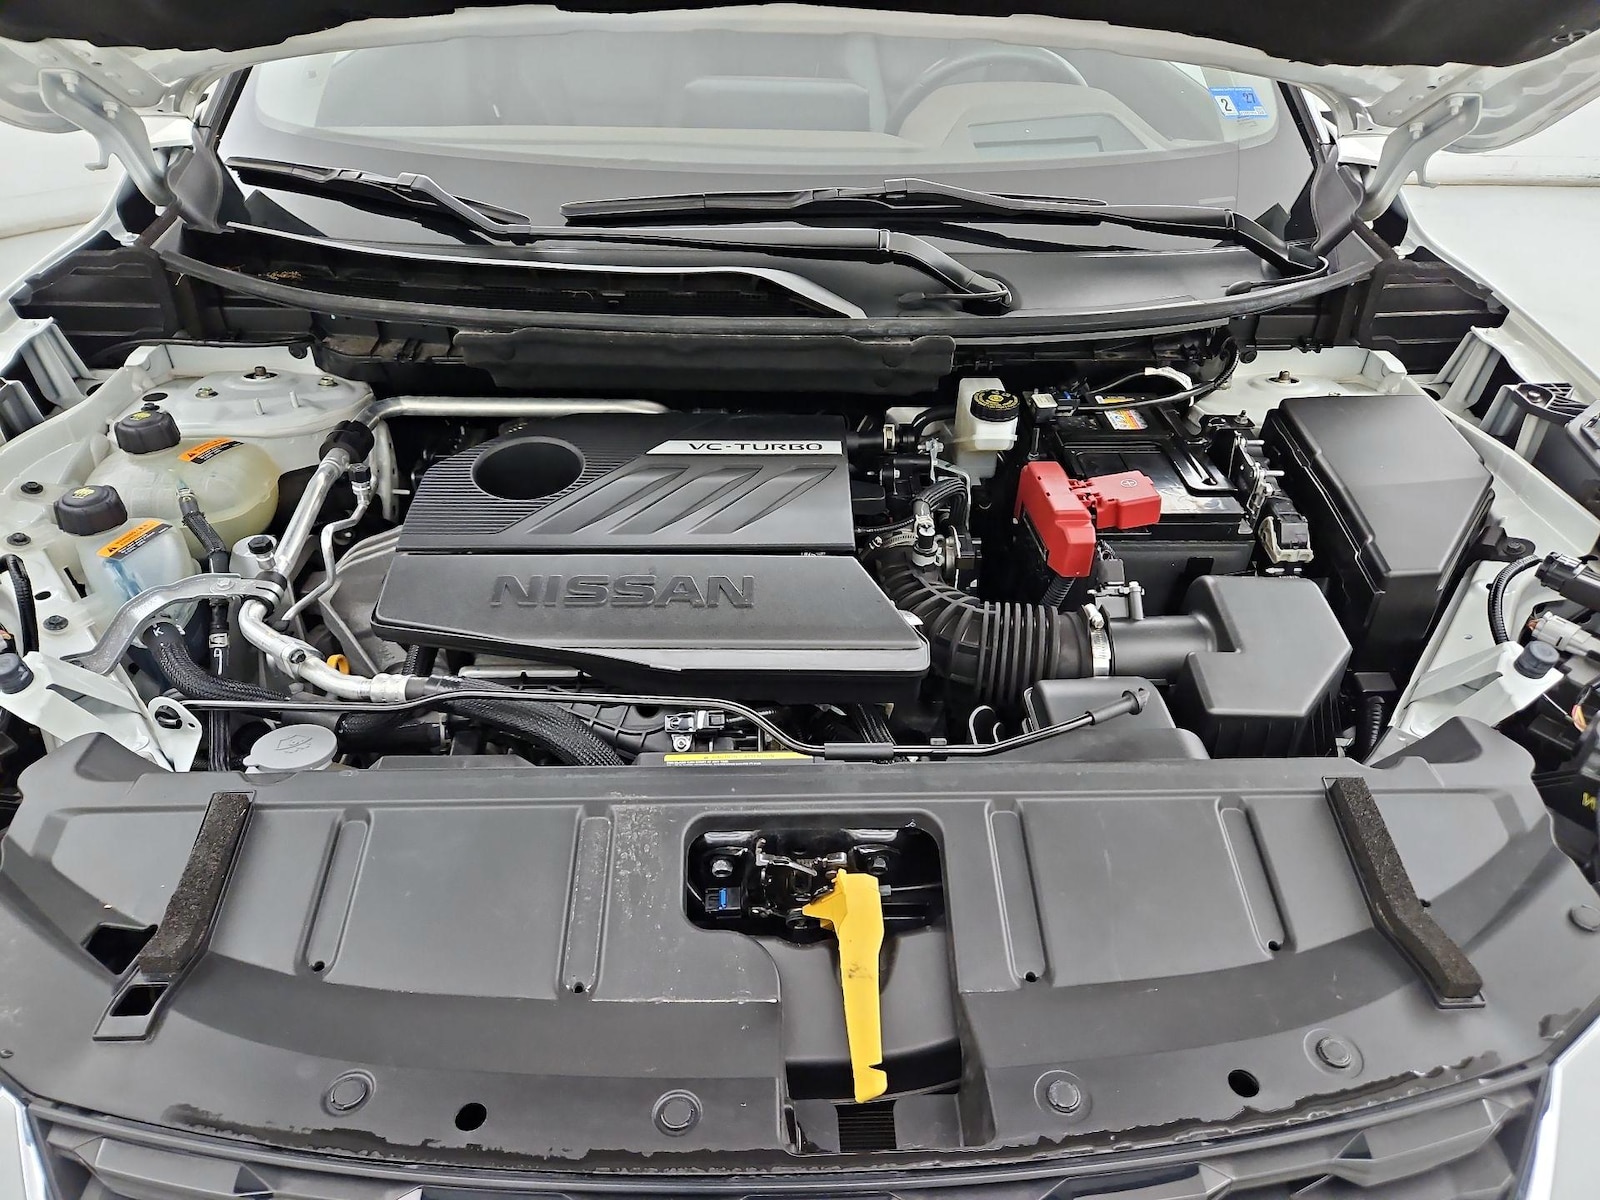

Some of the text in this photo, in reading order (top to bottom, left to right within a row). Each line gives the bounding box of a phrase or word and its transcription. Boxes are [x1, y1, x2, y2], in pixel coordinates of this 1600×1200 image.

[1242, 92, 1256, 103] 27
[1221, 98, 1232, 111] 2
[688, 442, 823, 451] VC-TURBO
[489, 574, 755, 608] NISSAN
